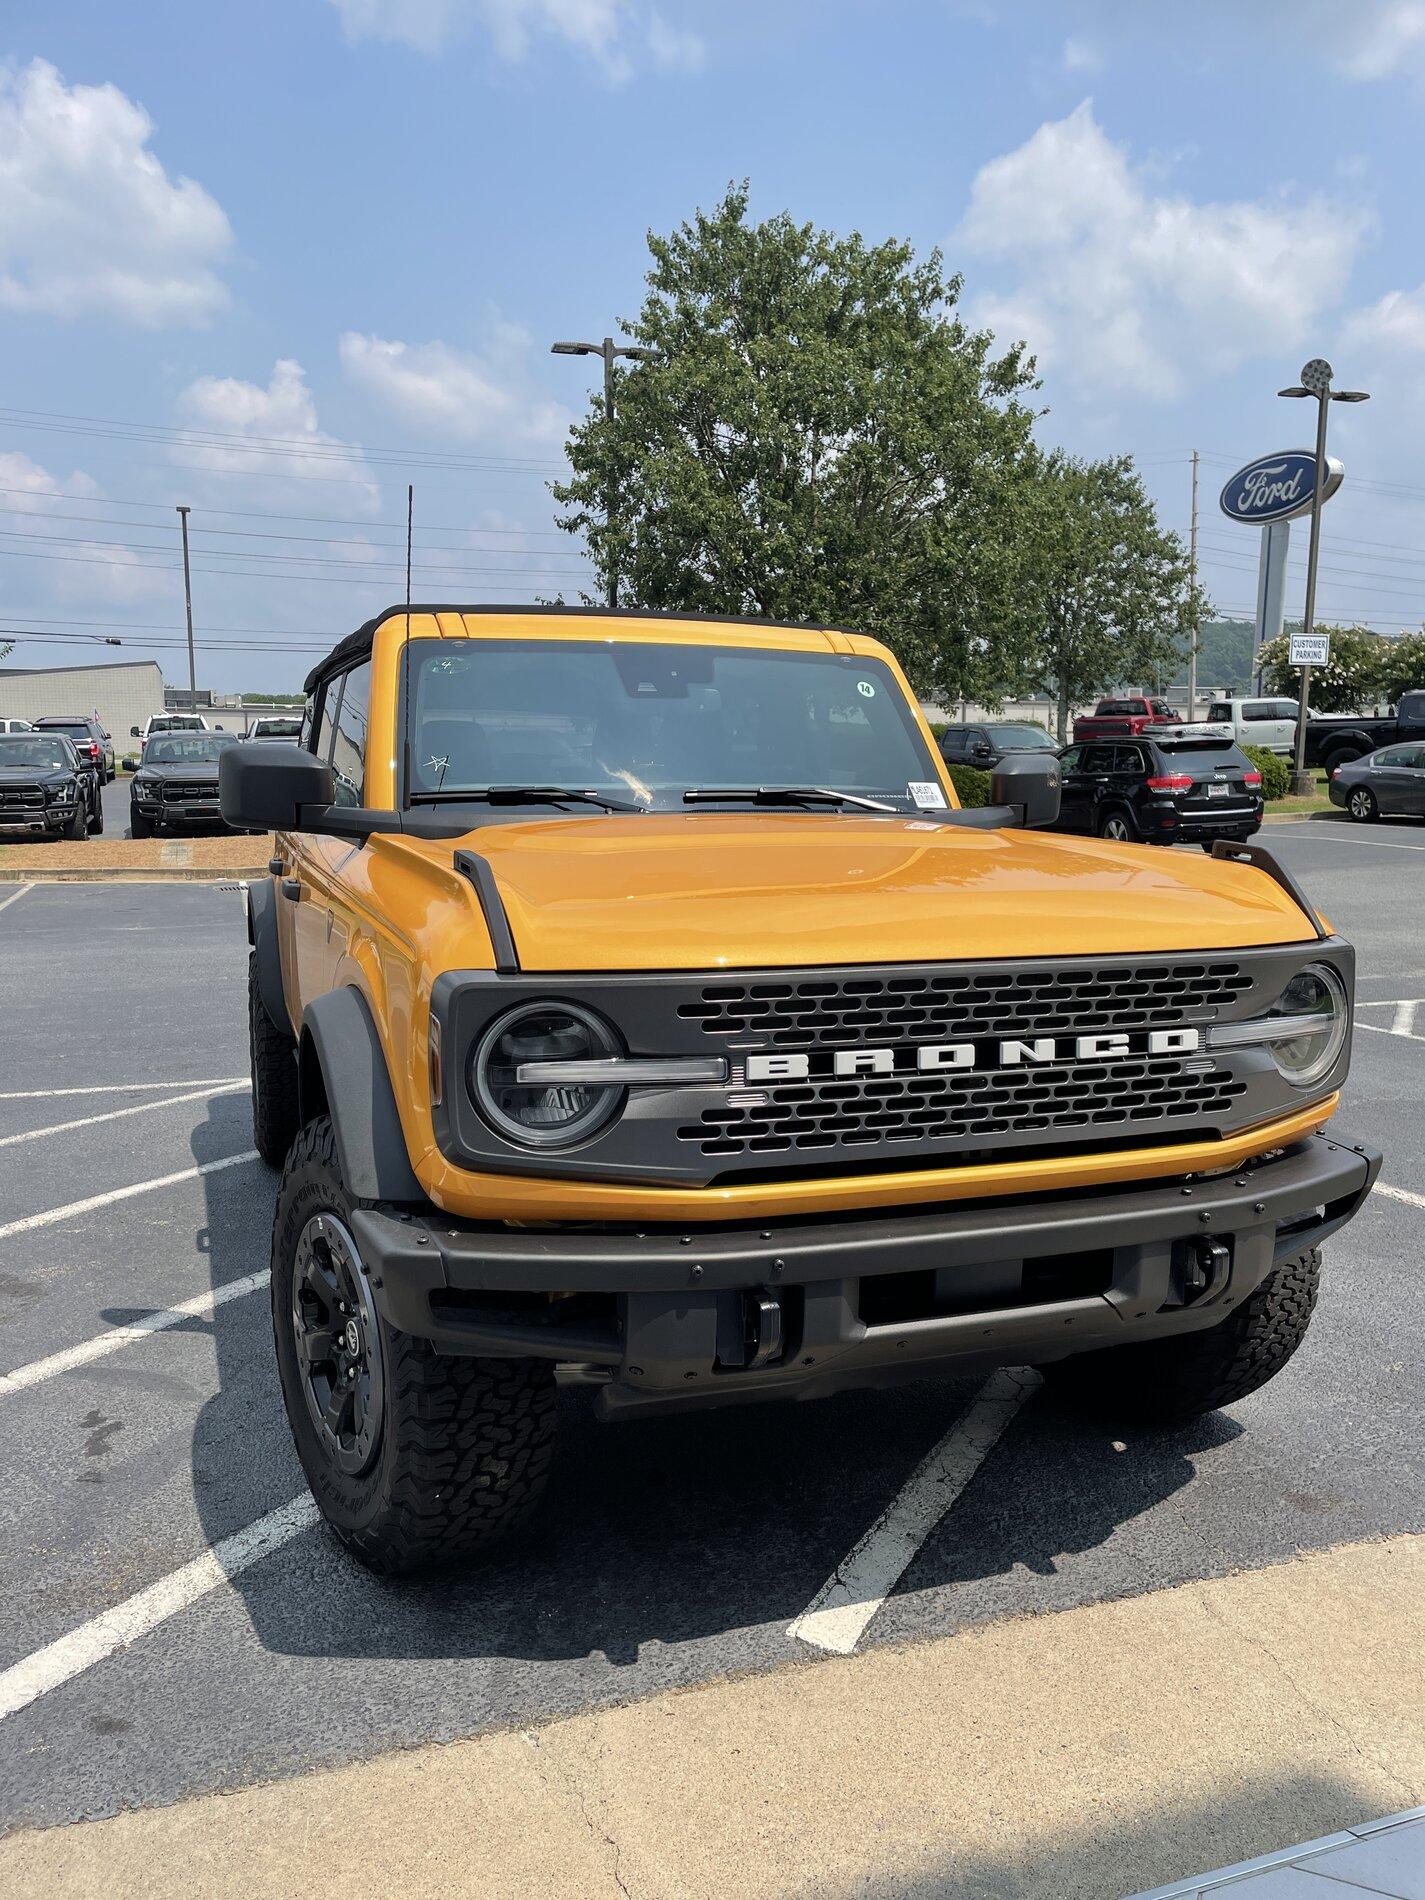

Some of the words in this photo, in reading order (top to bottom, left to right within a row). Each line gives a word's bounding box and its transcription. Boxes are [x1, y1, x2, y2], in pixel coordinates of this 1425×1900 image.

[1237, 463, 1304, 512] Ford
[1293, 639, 1326, 649] CUSTOMER
[1296, 650, 1322, 659] PARKING
[860, 683, 871, 694] 14
[162, 787, 219, 797] FOR
[745, 1028, 1199, 1081] BRONCO
